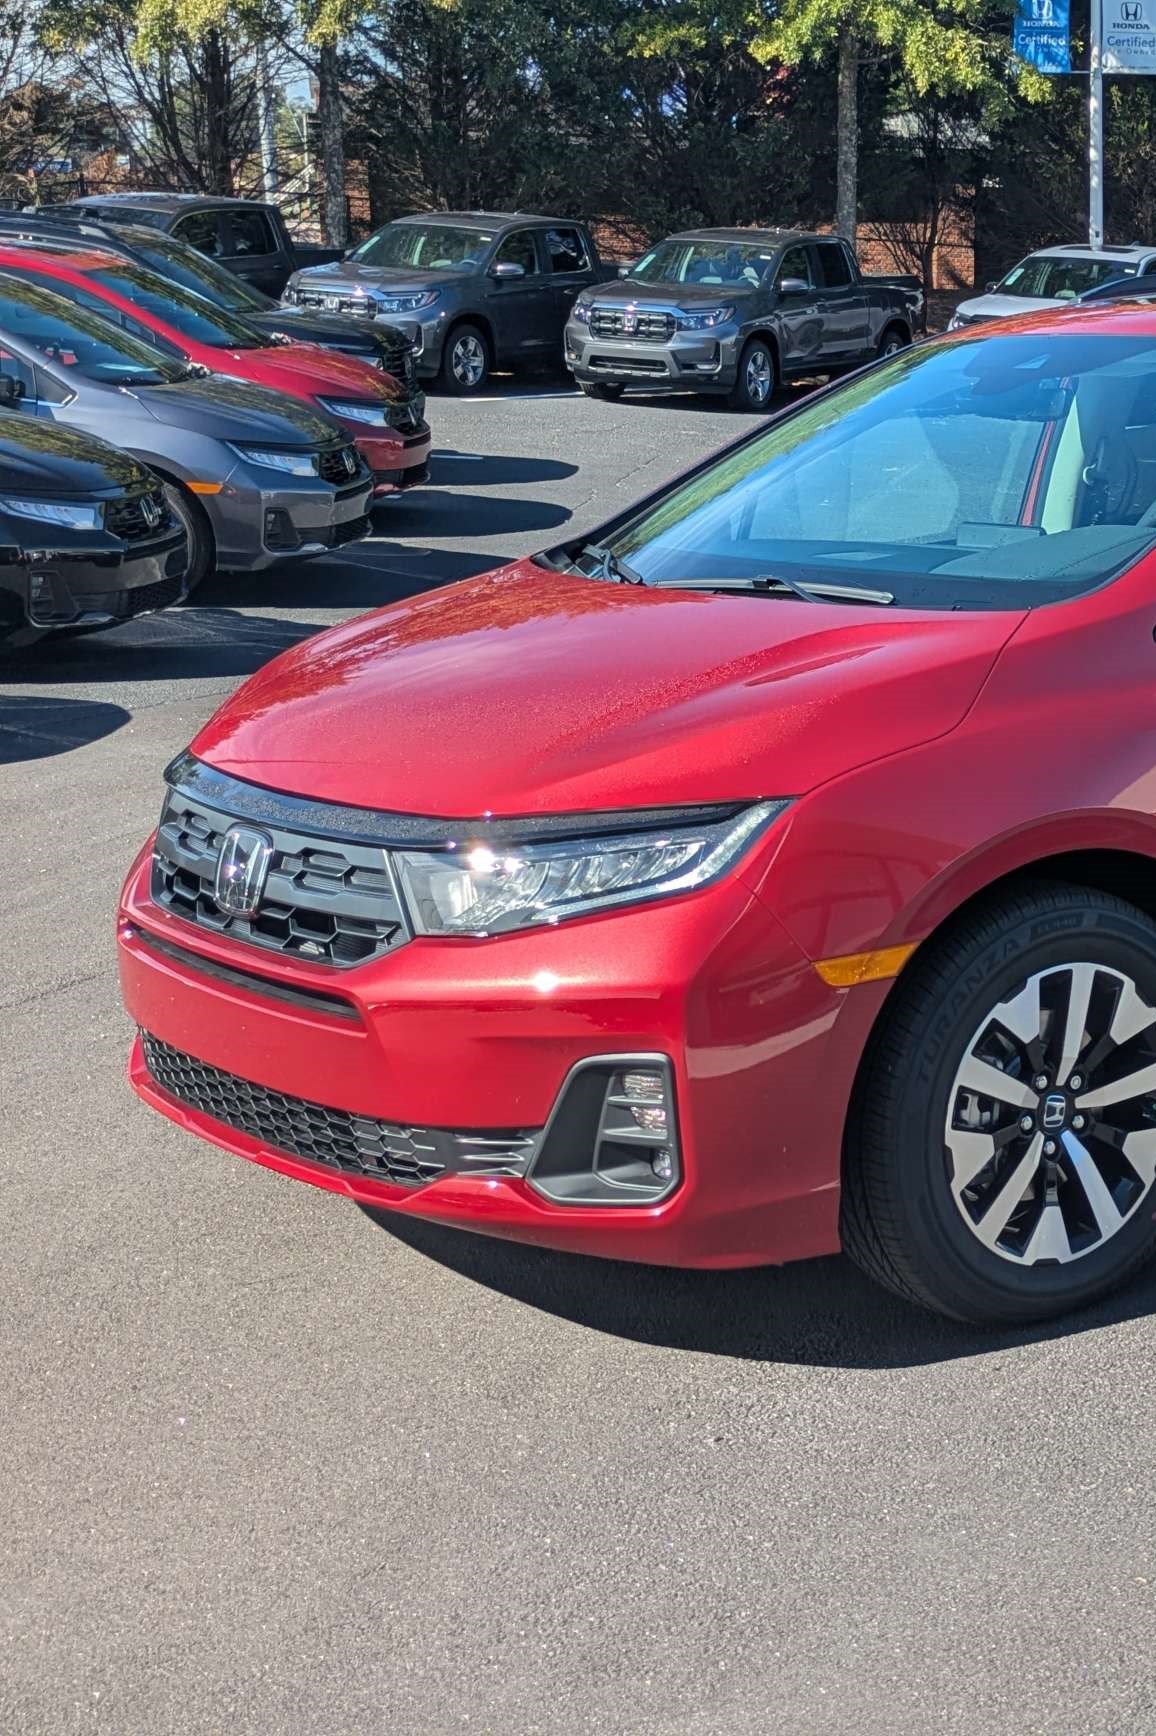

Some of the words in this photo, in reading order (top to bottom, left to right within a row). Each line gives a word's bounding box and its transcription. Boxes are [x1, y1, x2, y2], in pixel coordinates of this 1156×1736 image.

[1112, 22, 1150, 30] HONDA
[1018, 33, 1066, 46] Certified
[1107, 35, 1155, 48] Certified
